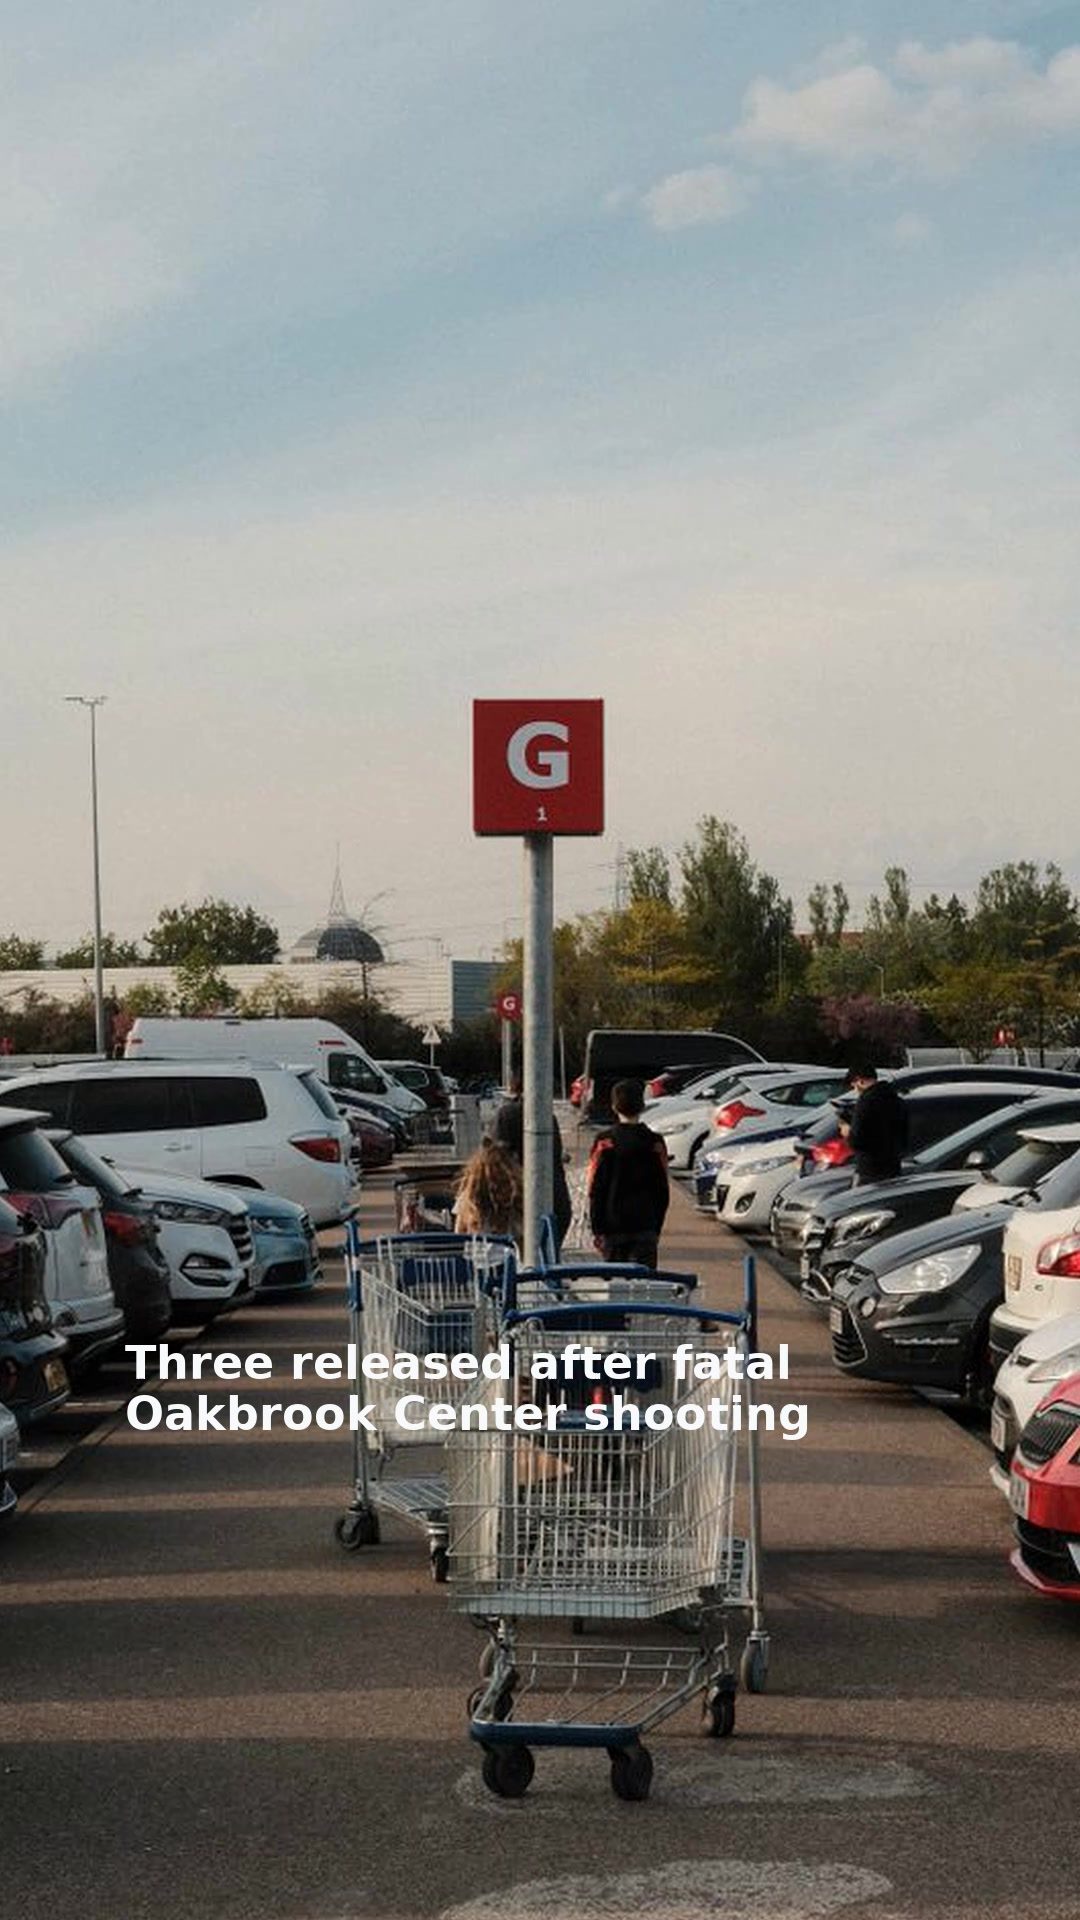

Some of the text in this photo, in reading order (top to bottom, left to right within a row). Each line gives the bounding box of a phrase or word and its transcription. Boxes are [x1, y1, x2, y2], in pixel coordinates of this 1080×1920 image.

[506, 720, 570, 790] G
[537, 806, 548, 821] 1
[503, 996, 516, 1010] G
